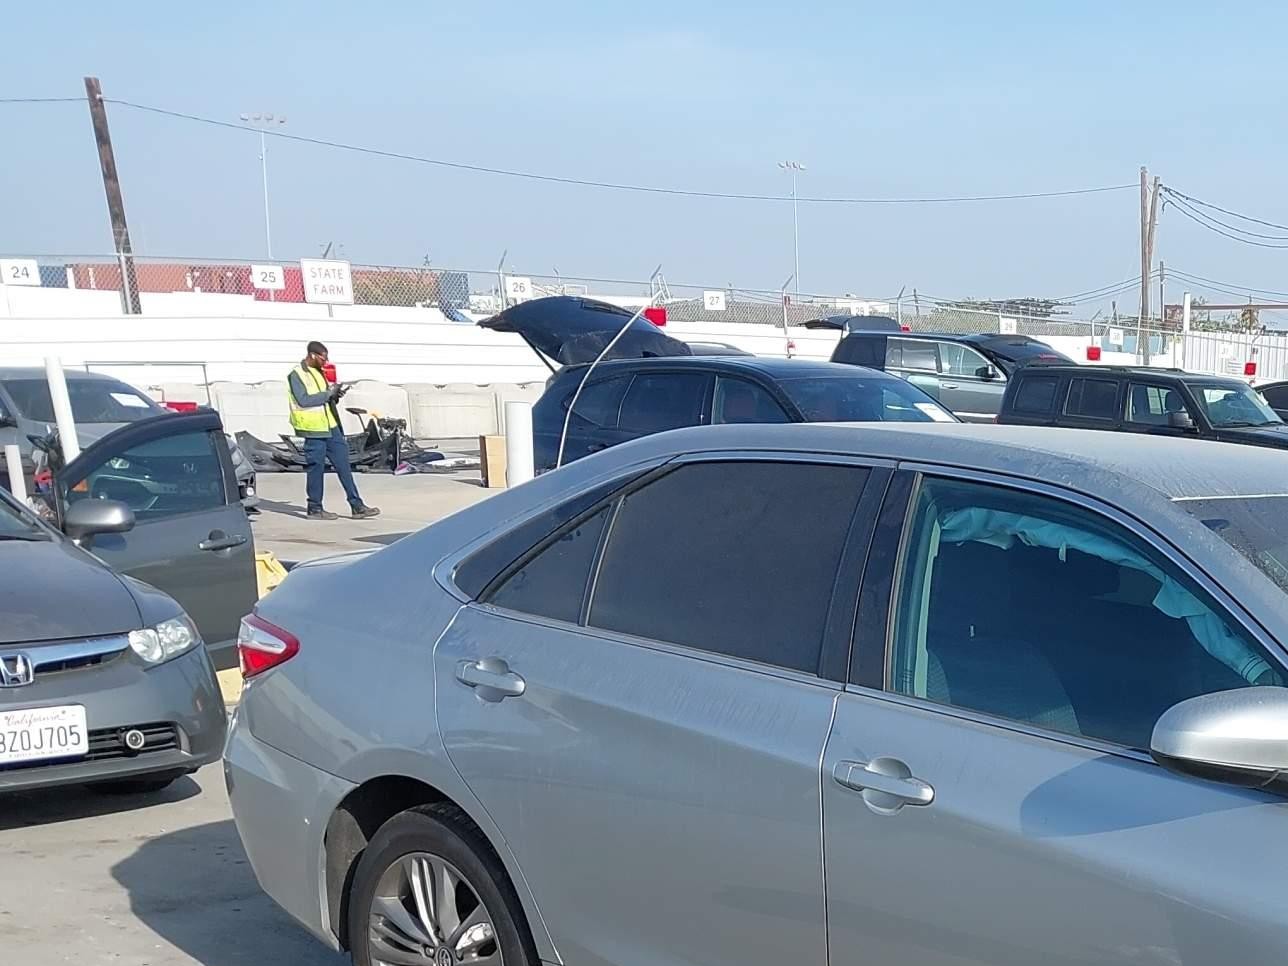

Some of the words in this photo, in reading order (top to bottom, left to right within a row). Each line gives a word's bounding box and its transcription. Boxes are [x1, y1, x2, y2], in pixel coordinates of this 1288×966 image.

[11, 266, 29, 279] 24
[260, 271, 276, 283] 25
[310, 267, 344, 280] STATE
[313, 284, 344, 296] FARM
[512, 282, 526, 293] 26
[709, 296, 720, 306] 27
